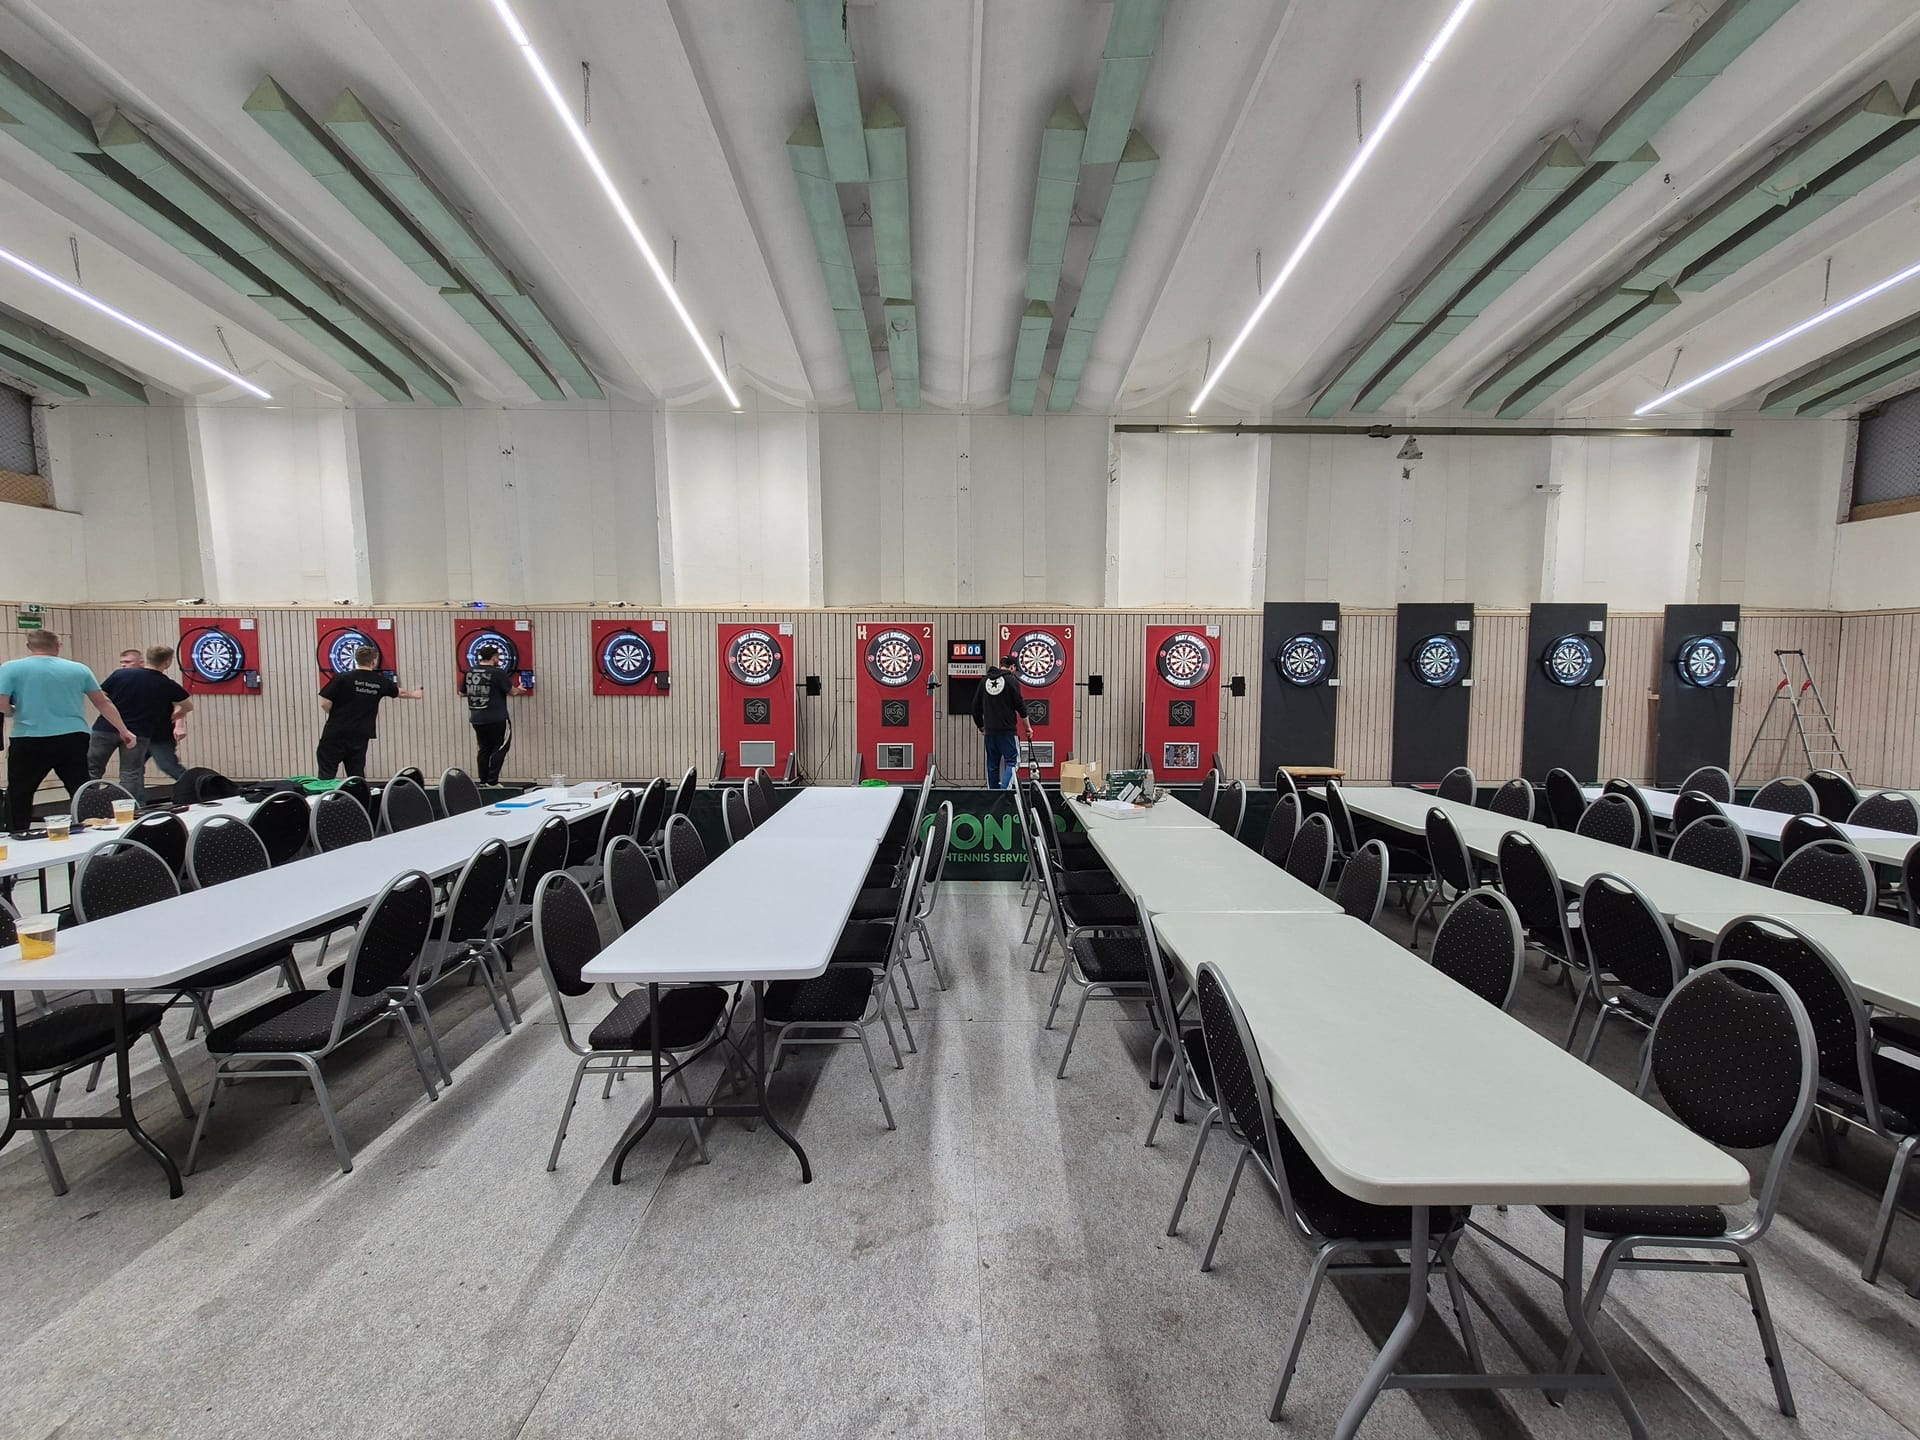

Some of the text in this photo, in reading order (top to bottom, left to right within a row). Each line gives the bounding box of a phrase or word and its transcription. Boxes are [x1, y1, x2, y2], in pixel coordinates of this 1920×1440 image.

[857, 625, 867, 640] H
[923, 626, 931, 638] 2
[1001, 626, 1011, 640] G
[1064, 627, 1072, 639] 3
[993, 852, 1029, 863] SERVIC
